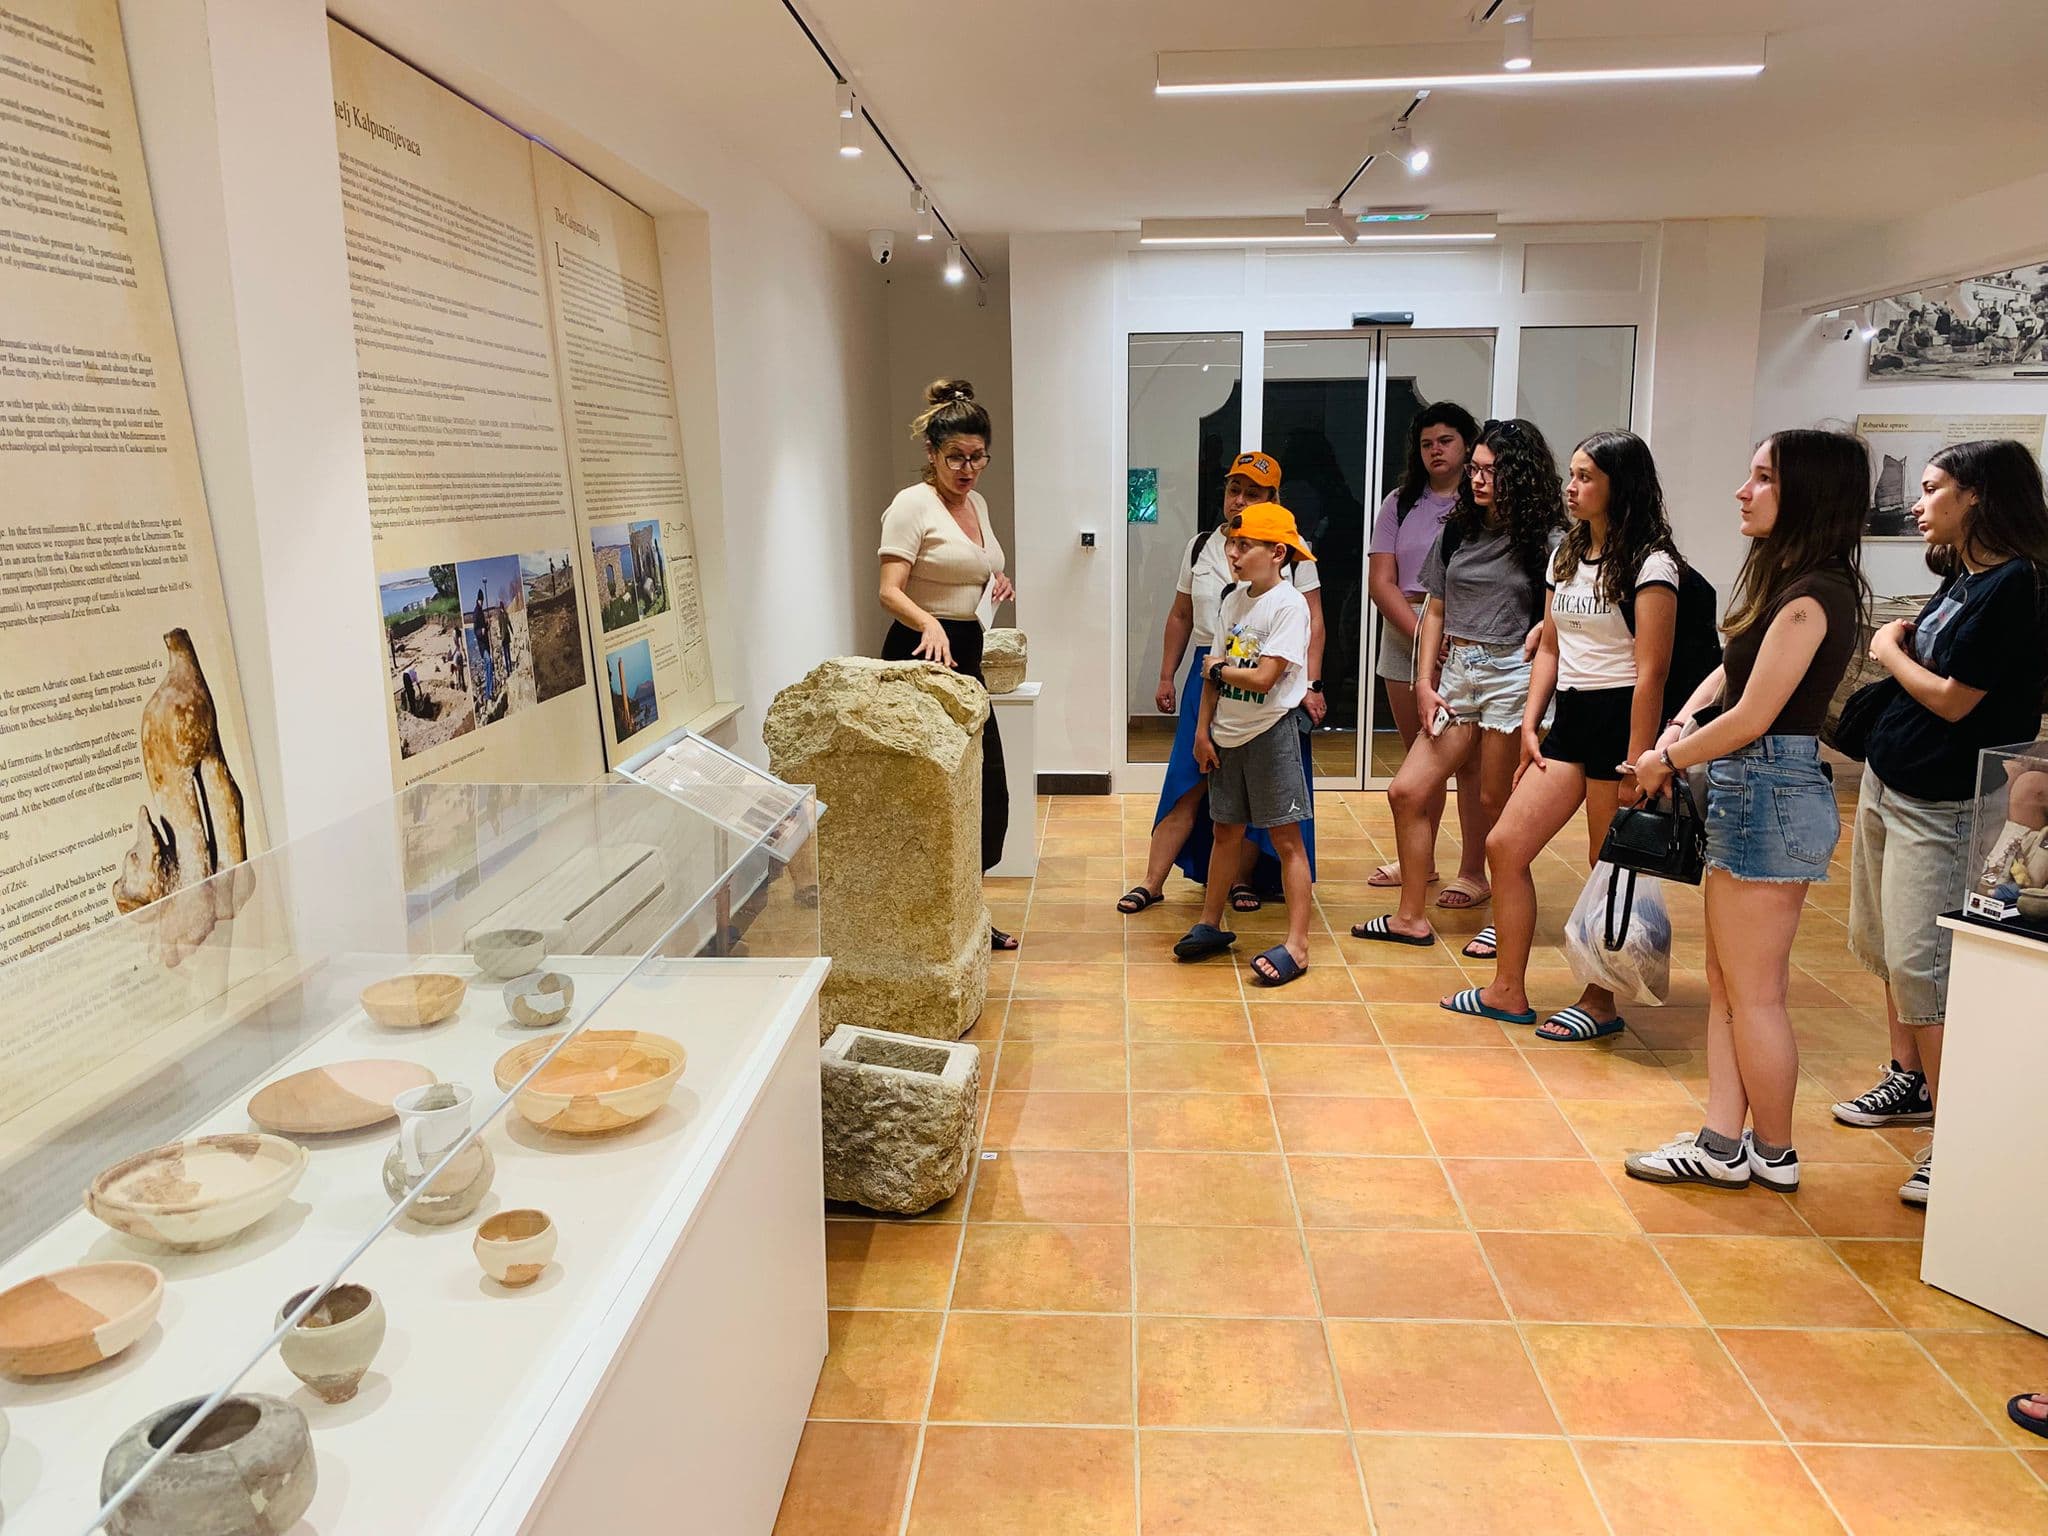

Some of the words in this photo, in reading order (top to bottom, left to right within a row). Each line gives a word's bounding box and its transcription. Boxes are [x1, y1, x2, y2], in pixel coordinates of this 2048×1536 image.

[352, 106, 421, 156] Kalpurnijevaca
[1553, 592, 1612, 615] EWCASTLE
[2, 688, 14, 699] the
[16, 685, 40, 696] eastern
[42, 679, 68, 691] Adriatic
[89, 669, 104, 681] Each
[106, 667, 122, 678] estate
[124, 660, 150, 674] consisted
[151, 658, 158, 669] of
[9, 705, 19, 715] for
[21, 698, 57, 715] processing
[58, 692, 70, 704] and
[71, 690, 93, 701] storing
[94, 686, 108, 696] farm
[137, 675, 156, 687] Richer
[20, 721, 28, 729] to
[28, 717, 46, 728] these
[74, 706, 88, 717] they
[88, 702, 101, 713] also
[102, 698, 113, 710] had
[118, 696, 135, 706] house
[7, 758, 24, 768] farm
[44, 748, 52, 758] In
[52, 745, 63, 756] the
[64, 739, 90, 753] northern
[90, 735, 103, 748] part
[103, 731, 110, 742] of
[110, 729, 120, 740] the
[10, 765, 42, 783] consisted
[42, 763, 50, 774] of
[50, 762, 64, 772] two
[64, 752, 90, 771] partially
[91, 745, 112, 760] walled
[112, 743, 120, 754] off
[121, 740, 137, 752] cellar
[17, 787, 32, 798] they
[33, 783, 50, 793] were
[51, 770, 82, 788] converted
[84, 768, 96, 778] into
[96, 758, 121, 775] disposal
[122, 757, 133, 770] pits
[21, 804, 30, 814] At
[30, 800, 42, 811] the
[42, 795, 66, 808] bottom
[67, 789, 74, 800] of
[74, 788, 86, 797] one
[87, 782, 95, 794] of
[95, 780, 105, 791] the
[105, 775, 122, 788] cellar
[122, 771, 142, 782] money
[25, 857, 33, 868] of
[38, 850, 58, 863] lesser
[58, 843, 77, 855] scope
[77, 831, 104, 848] revealed
[104, 827, 117, 839] only
[122, 822, 133, 832] few
[1, 883, 9, 894] of
[5, 896, 34, 913] location
[35, 885, 55, 901] called
[55, 879, 69, 892] Pod
[86, 869, 101, 880] have
[101, 863, 116, 874] been
[7, 915, 20, 928] and
[21, 904, 52, 922] intensive
[53, 894, 78, 909] erosion
[79, 890, 86, 898] or
[96, 880, 106, 891] the
[8, 922, 51, 945] construction
[83, 897, 108, 913] obvious
[19, 932, 62, 958] underground
[63, 922, 90, 939] standing
